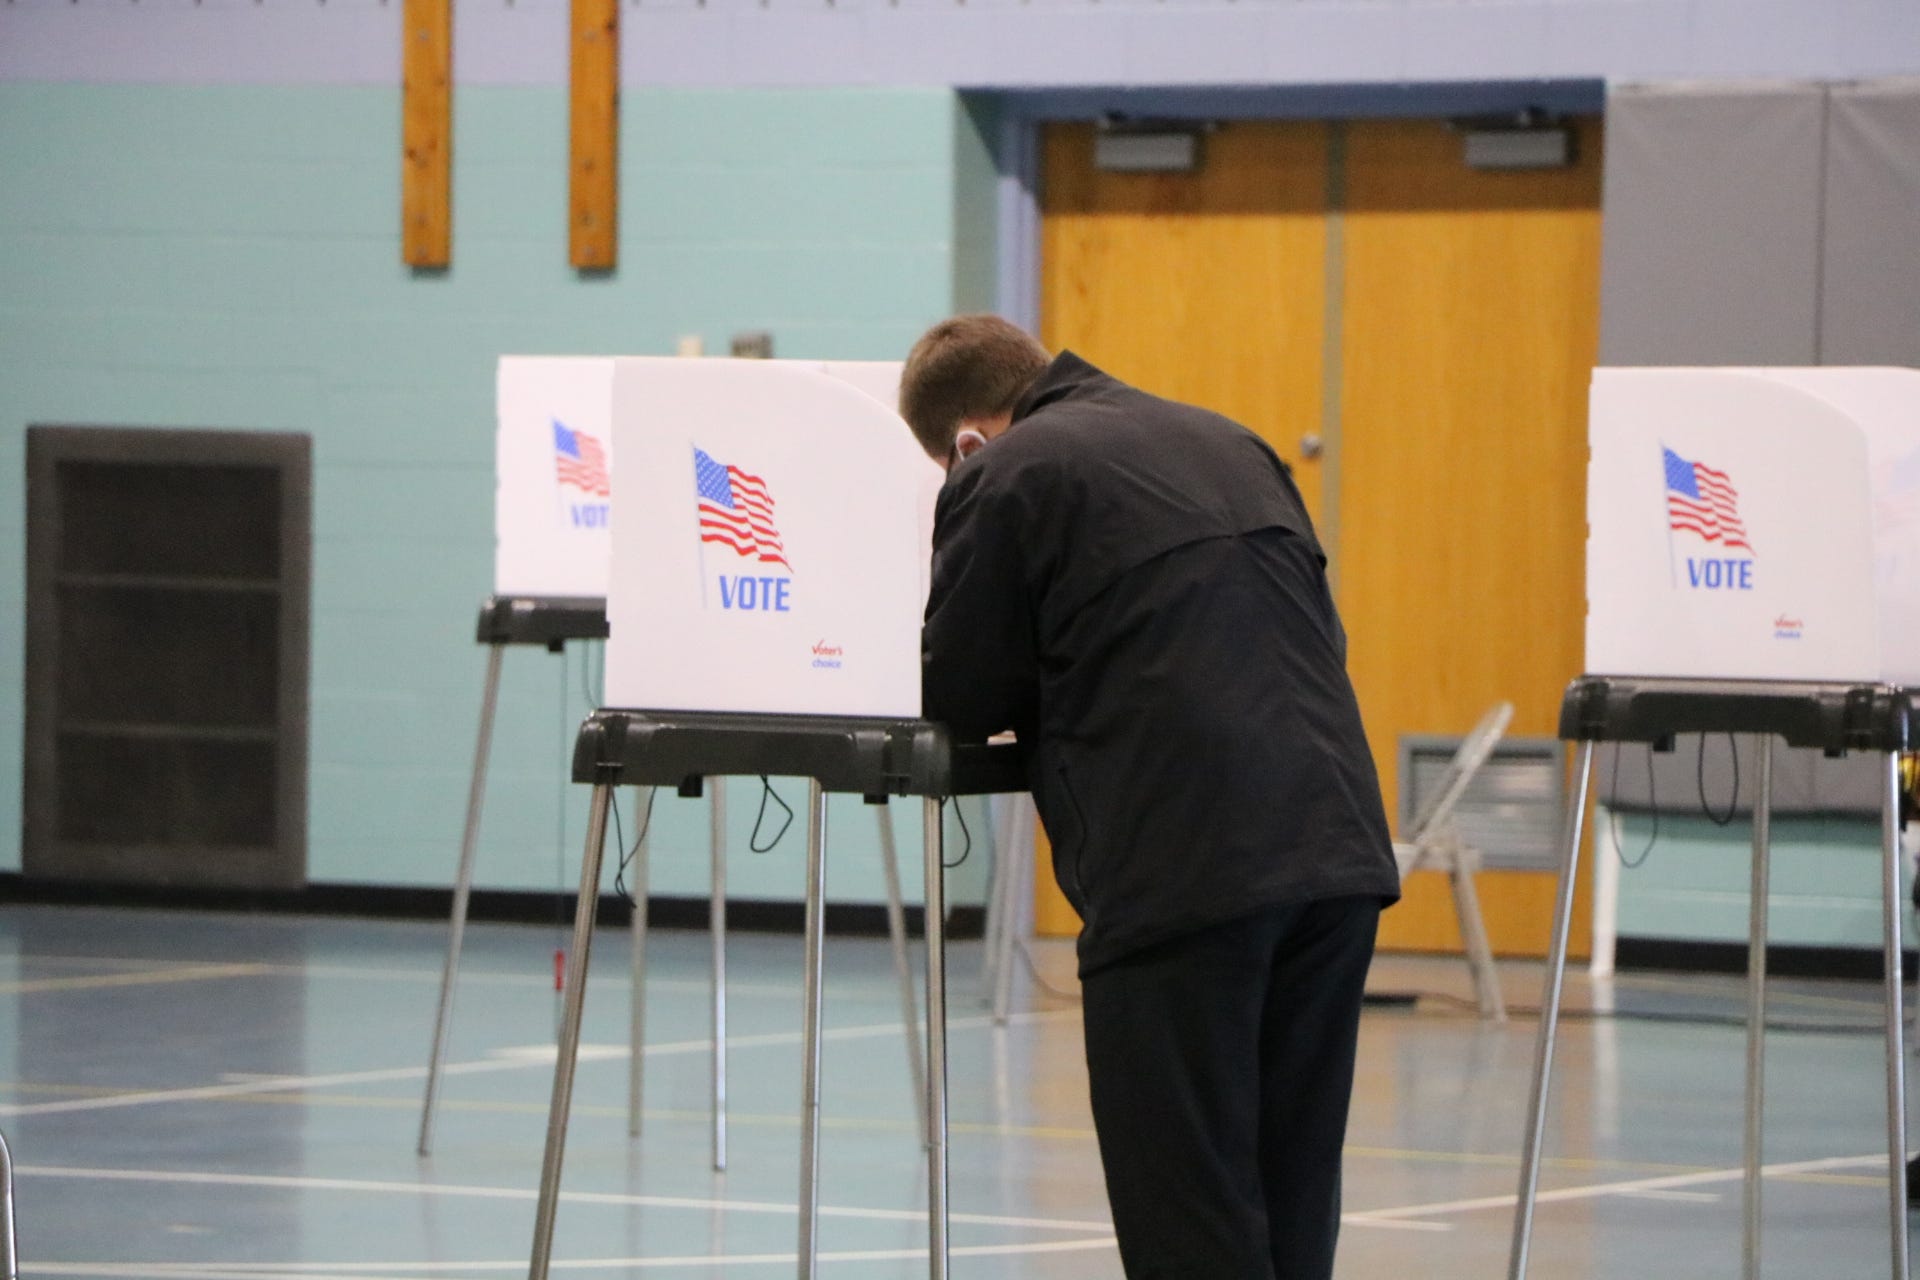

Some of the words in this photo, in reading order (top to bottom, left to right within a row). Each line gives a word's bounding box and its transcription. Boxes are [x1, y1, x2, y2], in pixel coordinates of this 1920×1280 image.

[571, 504, 610, 528] VOT
[1687, 558, 1753, 589] VOTE
[719, 575, 791, 611] VOTE
